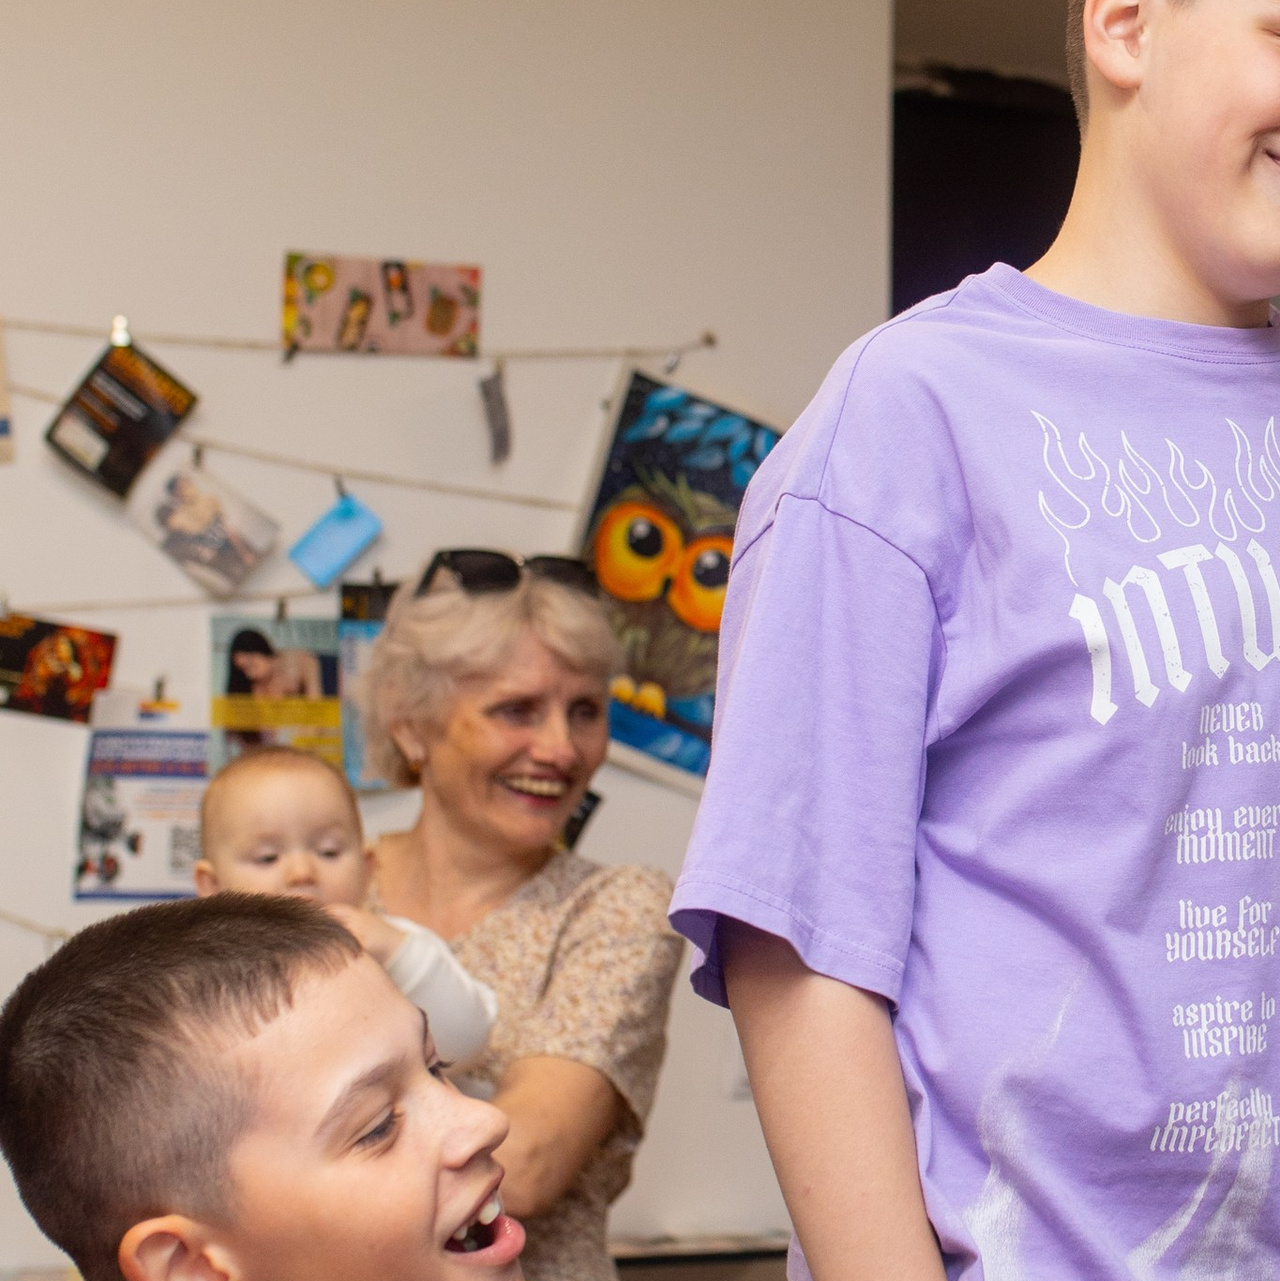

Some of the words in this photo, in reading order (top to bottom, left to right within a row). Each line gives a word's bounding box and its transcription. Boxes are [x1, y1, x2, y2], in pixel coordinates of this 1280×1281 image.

[1181, 736, 1219, 770] look
[1163, 803, 1222, 838] enjoy
[1179, 899, 1227, 930] live
[1238, 895, 1272, 932] for
[1172, 995, 1254, 1033] aspire
[1260, 991, 1277, 1021] to
[1165, 1087, 1276, 1132] perfectly
